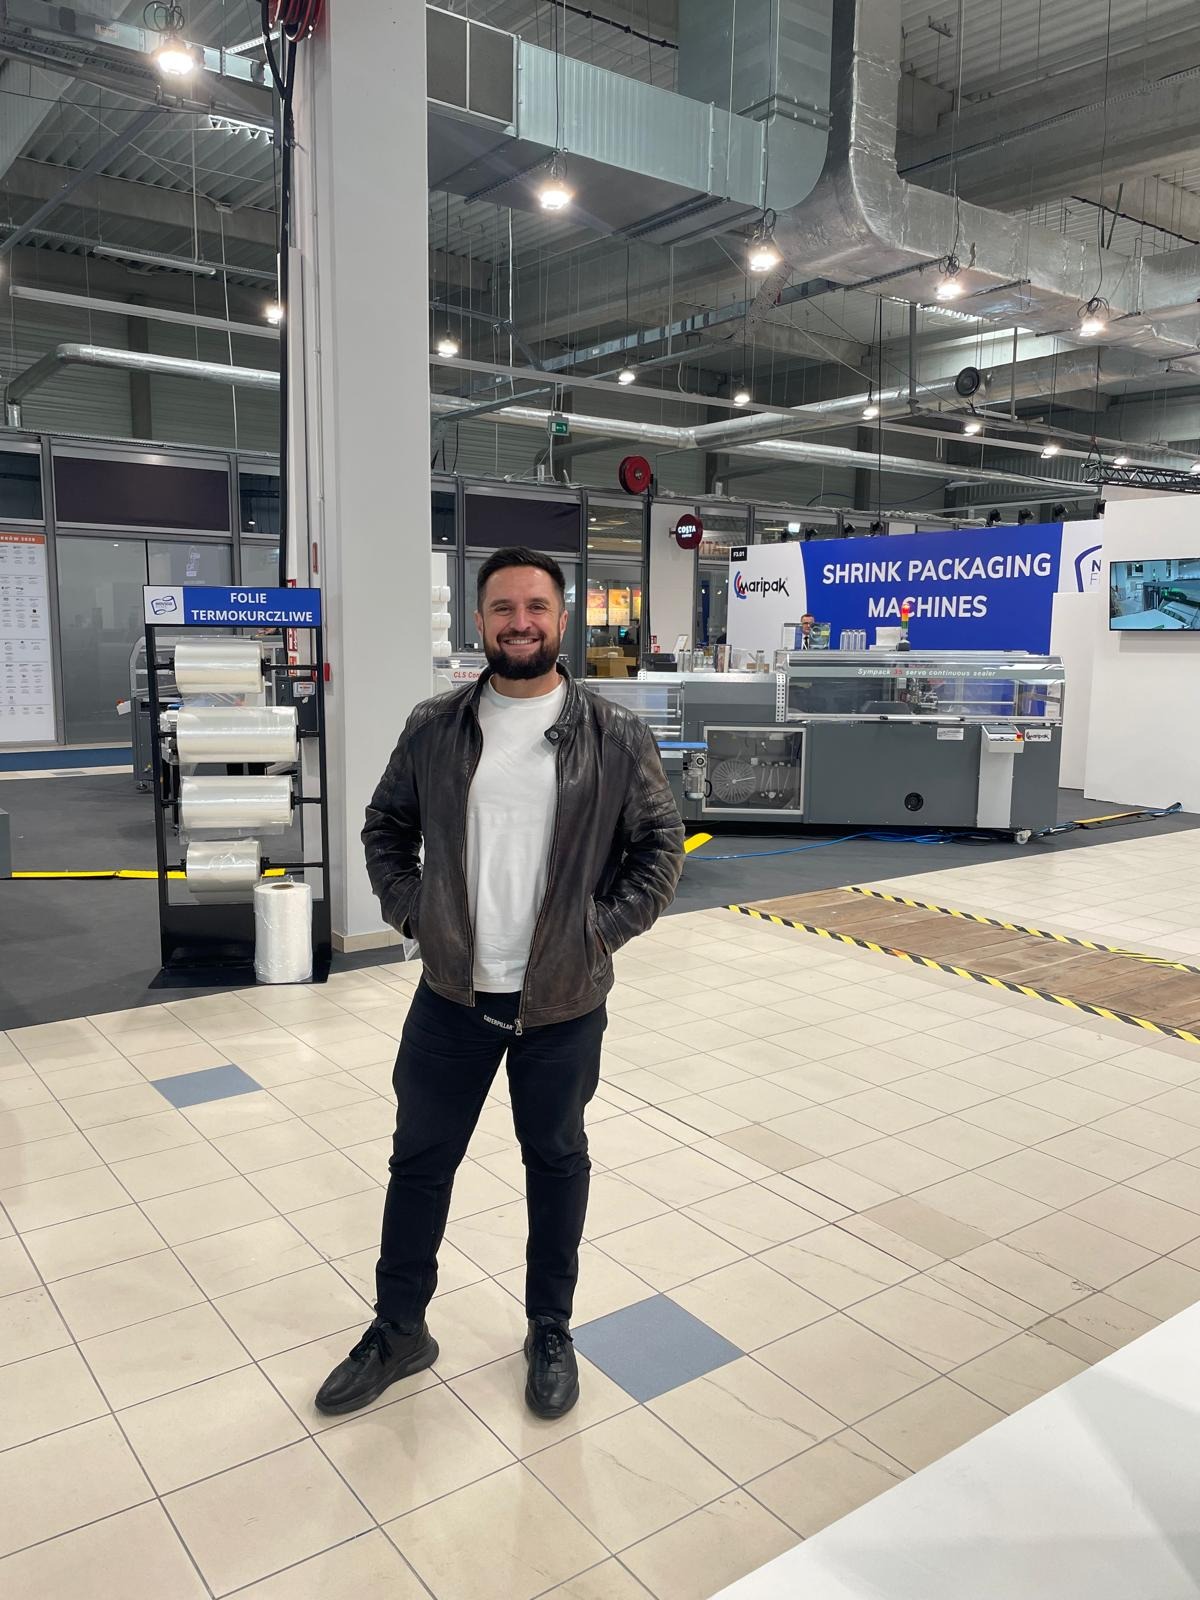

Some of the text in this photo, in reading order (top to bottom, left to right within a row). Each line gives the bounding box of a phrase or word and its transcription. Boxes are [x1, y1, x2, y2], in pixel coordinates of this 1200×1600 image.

[677, 525, 697, 534] COSTA
[822, 552, 1052, 585] SHRINK PACKAGING
[230, 592, 267, 604] FOLIE
[867, 594, 988, 618] MACHINES
[191, 609, 313, 622] TERMOKURCZLIWE
[453, 671, 467, 679] CLS
[857, 668, 891, 676] Sympack
[928, 669, 970, 677] continuous
[484, 1014, 513, 1030] CATERPILLAR
